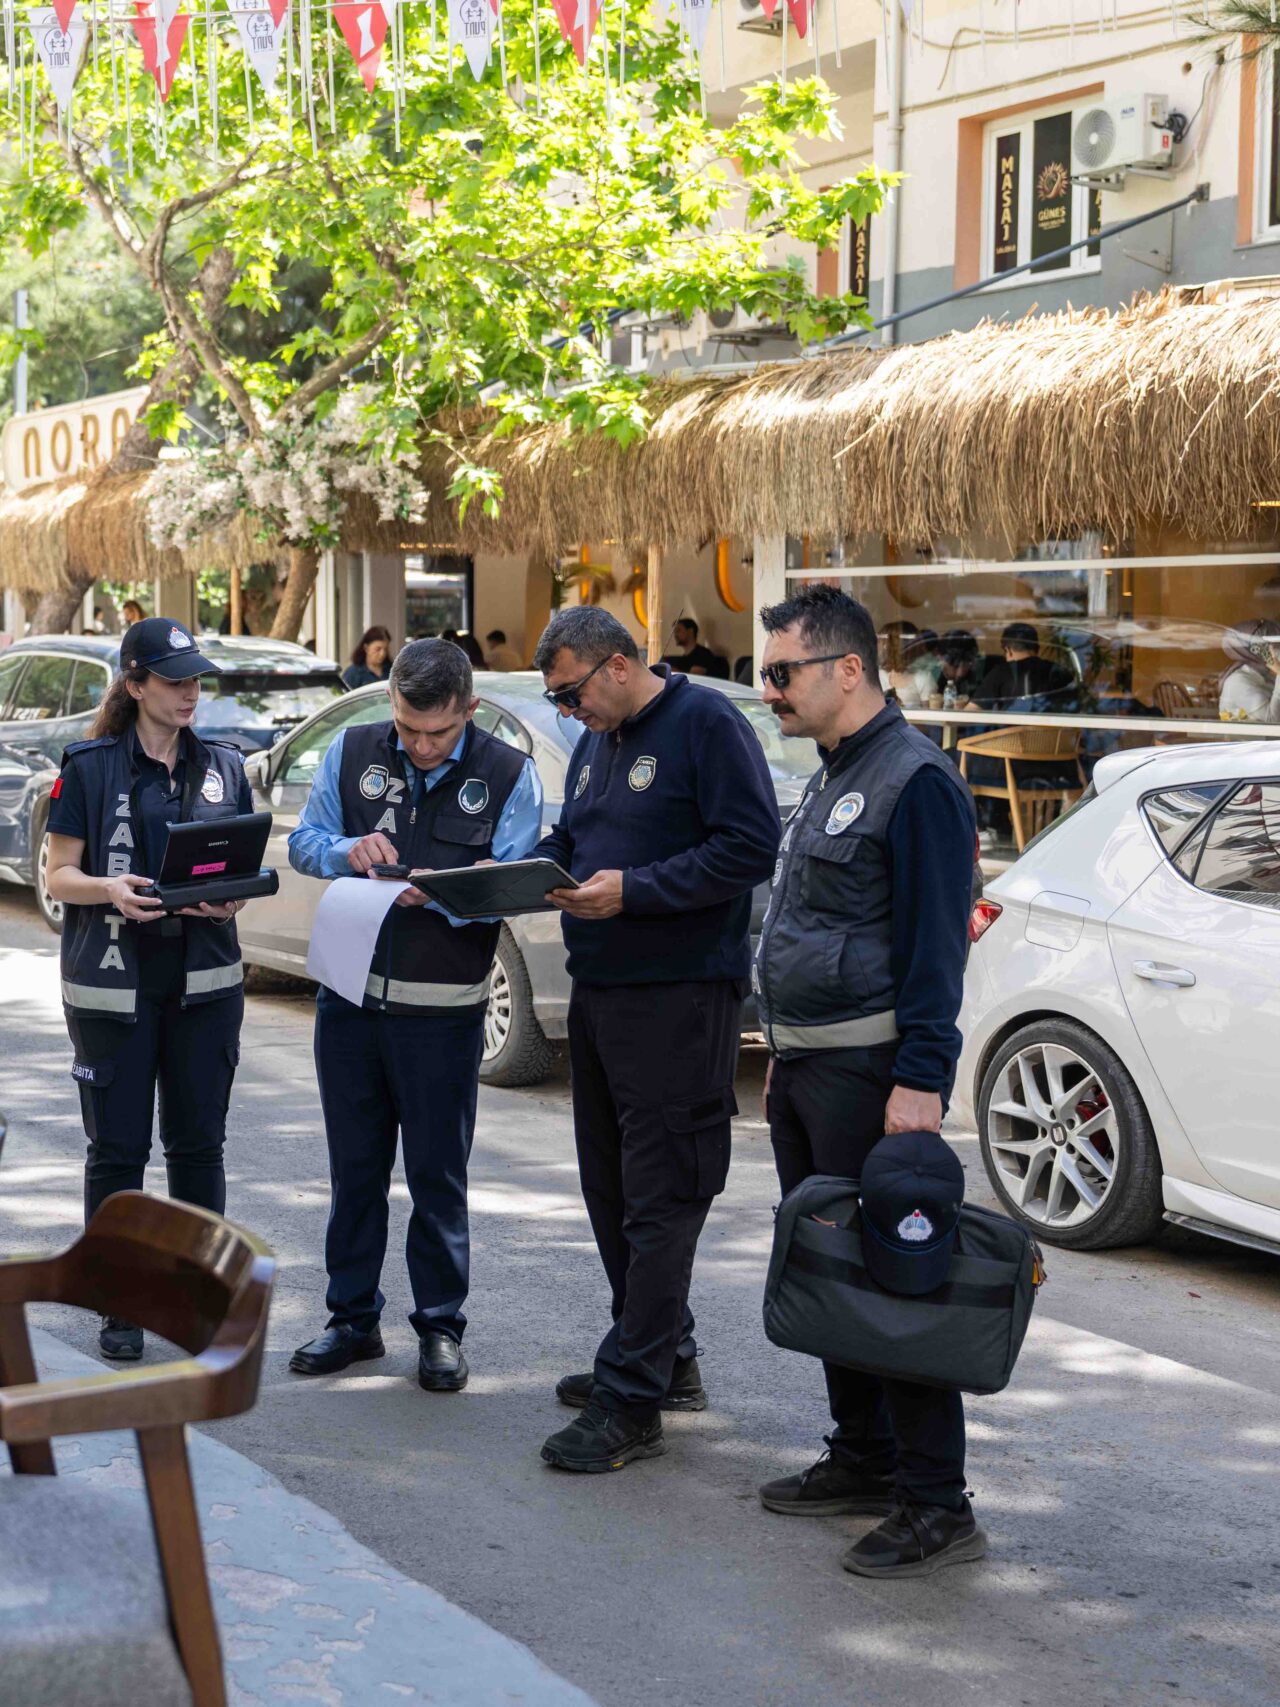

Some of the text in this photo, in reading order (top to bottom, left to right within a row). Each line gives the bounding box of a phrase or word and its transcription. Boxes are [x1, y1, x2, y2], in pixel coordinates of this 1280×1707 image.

[1001, 154, 1015, 242] MASAJ
[98, 793, 135, 971] ZABTA
[72, 1063, 94, 1081] ZABITA
